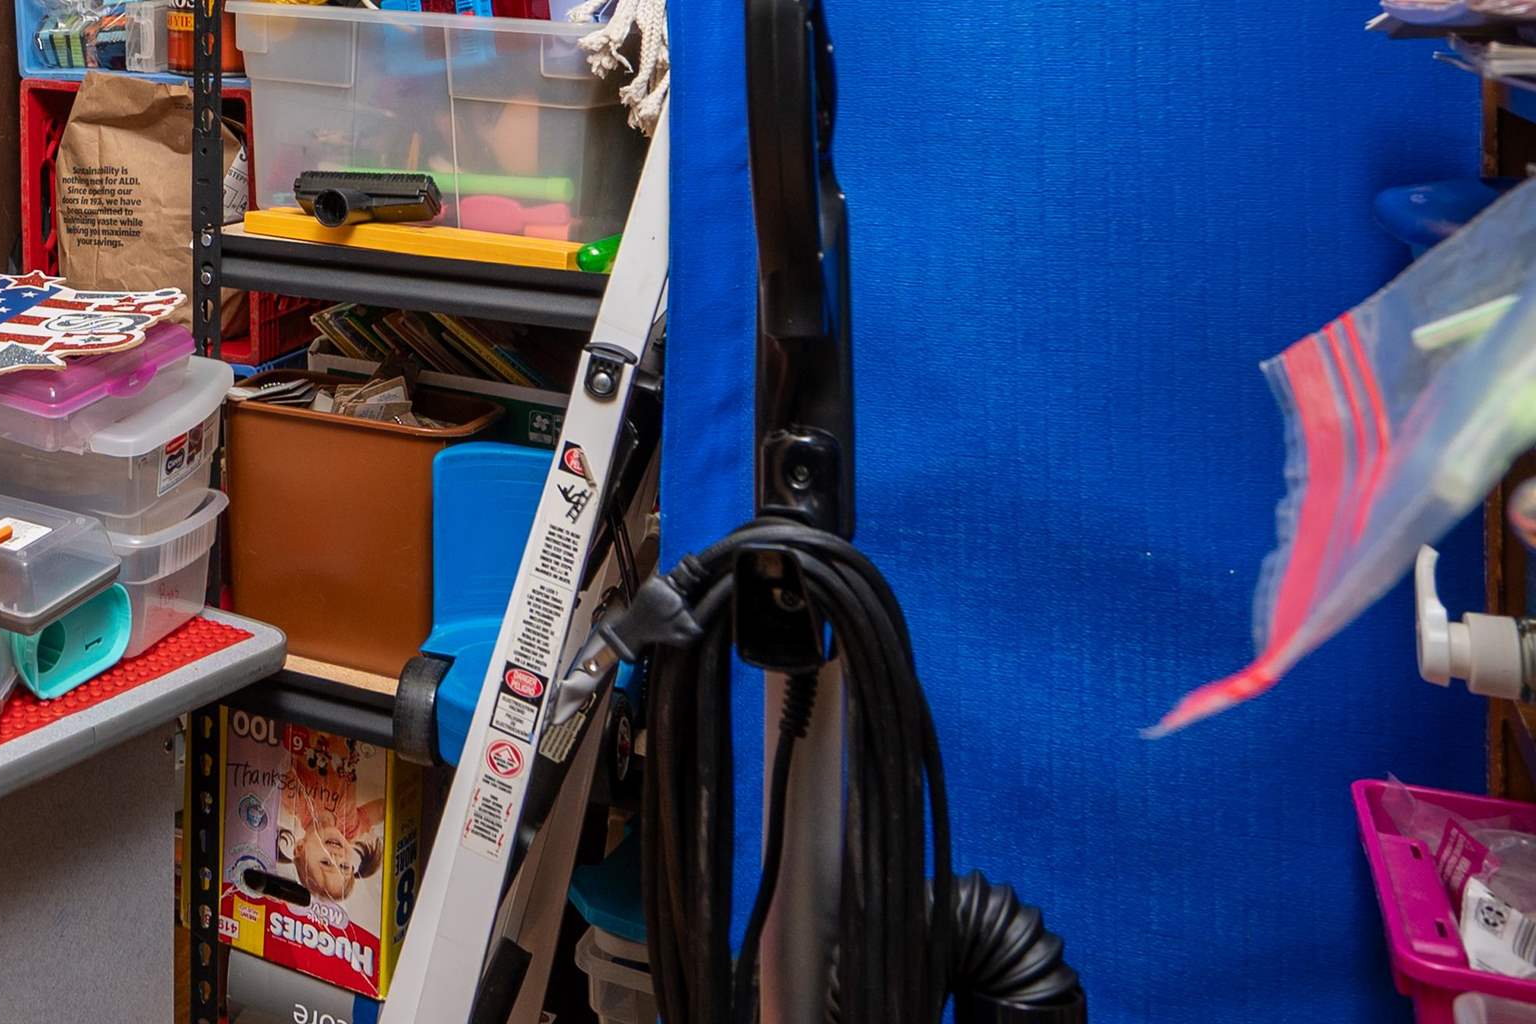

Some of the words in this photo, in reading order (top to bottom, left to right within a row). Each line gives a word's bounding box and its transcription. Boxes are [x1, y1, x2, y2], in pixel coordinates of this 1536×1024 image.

[121, 166, 128, 175] is
[104, 176, 117, 185] for
[118, 177, 141, 185] ALDI.
[67, 186, 88, 195] Since
[80, 196, 89, 205] in
[119, 197, 142, 206] have
[119, 217, 143, 226] while
[101, 228, 141, 237] maximize
[227, 762, 342, 812] Thanksgiving
[269, 911, 375, 977] HUGGIES
